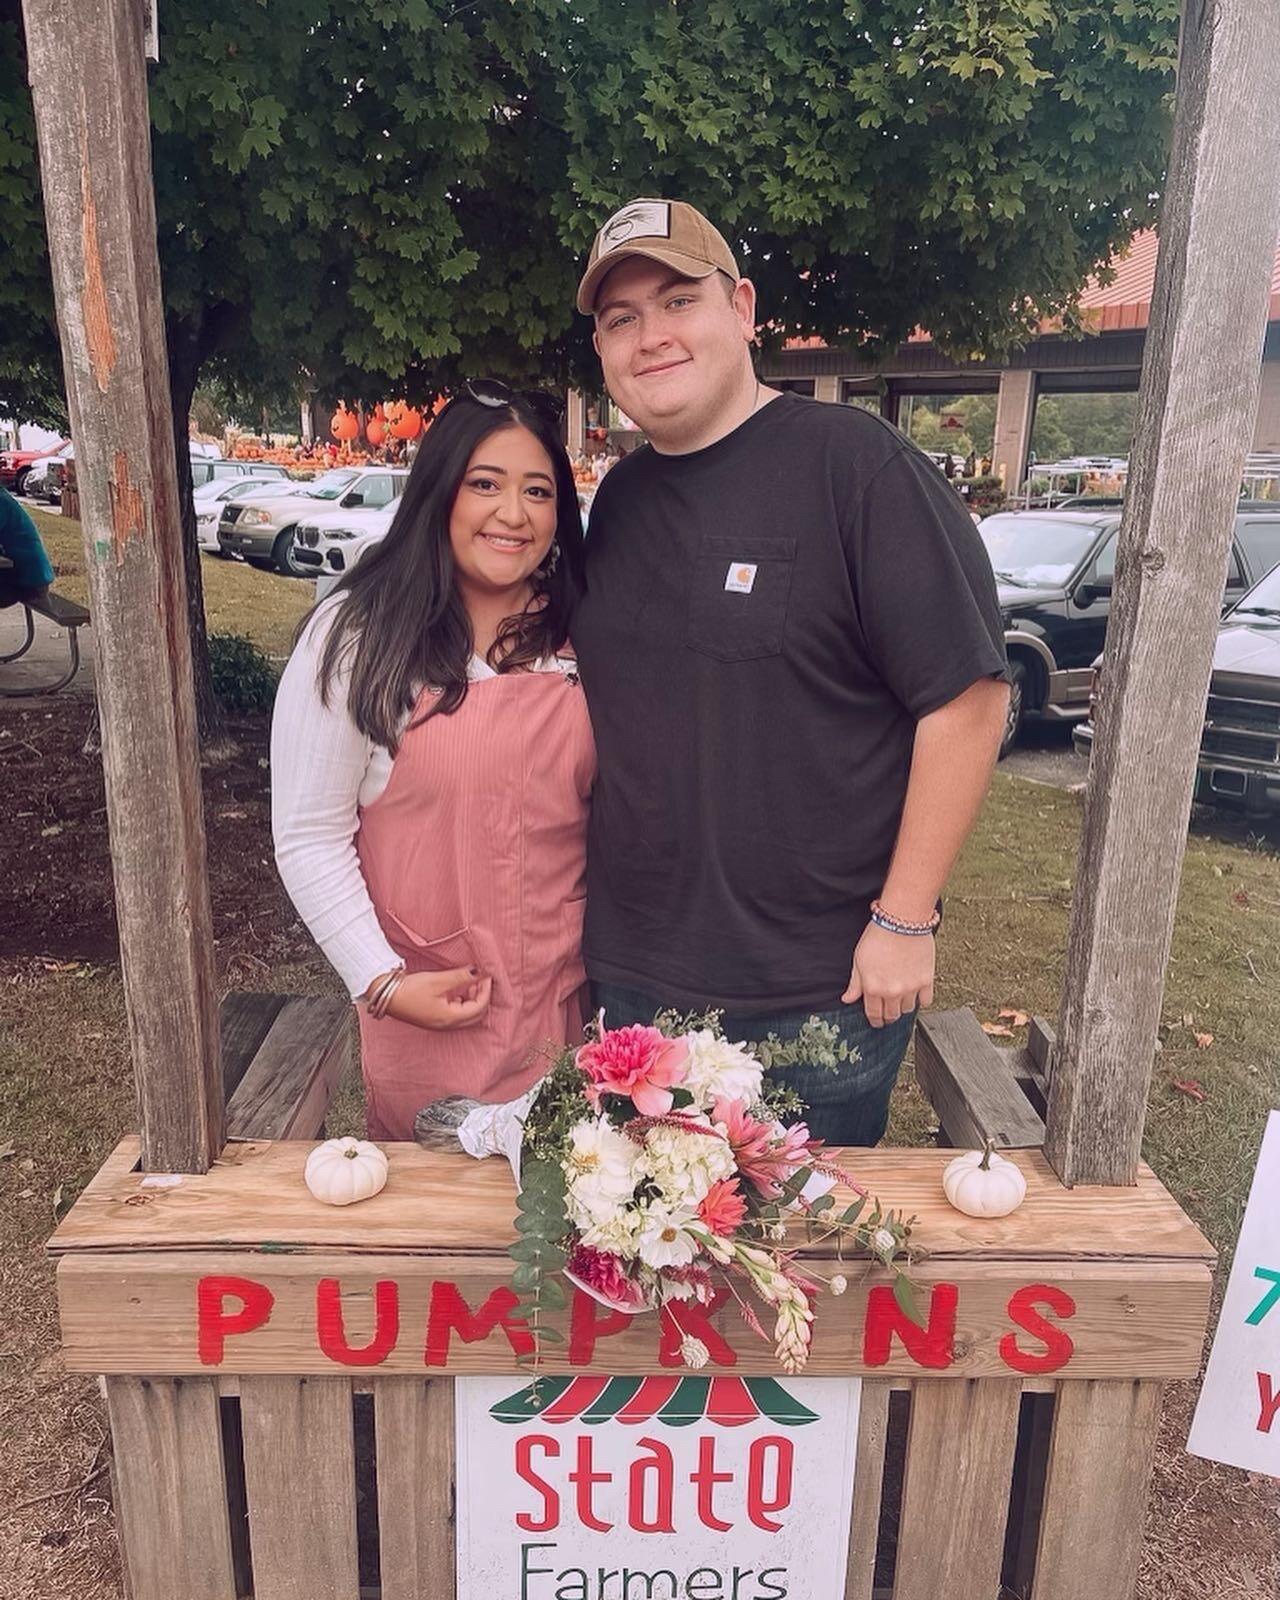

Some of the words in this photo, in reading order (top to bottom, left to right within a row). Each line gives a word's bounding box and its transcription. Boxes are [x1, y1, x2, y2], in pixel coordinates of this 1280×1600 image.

[195, 1274, 1077, 1375] PUMPKNS
[515, 1434, 794, 1533] State
[520, 1542, 788, 1600] Farmers
